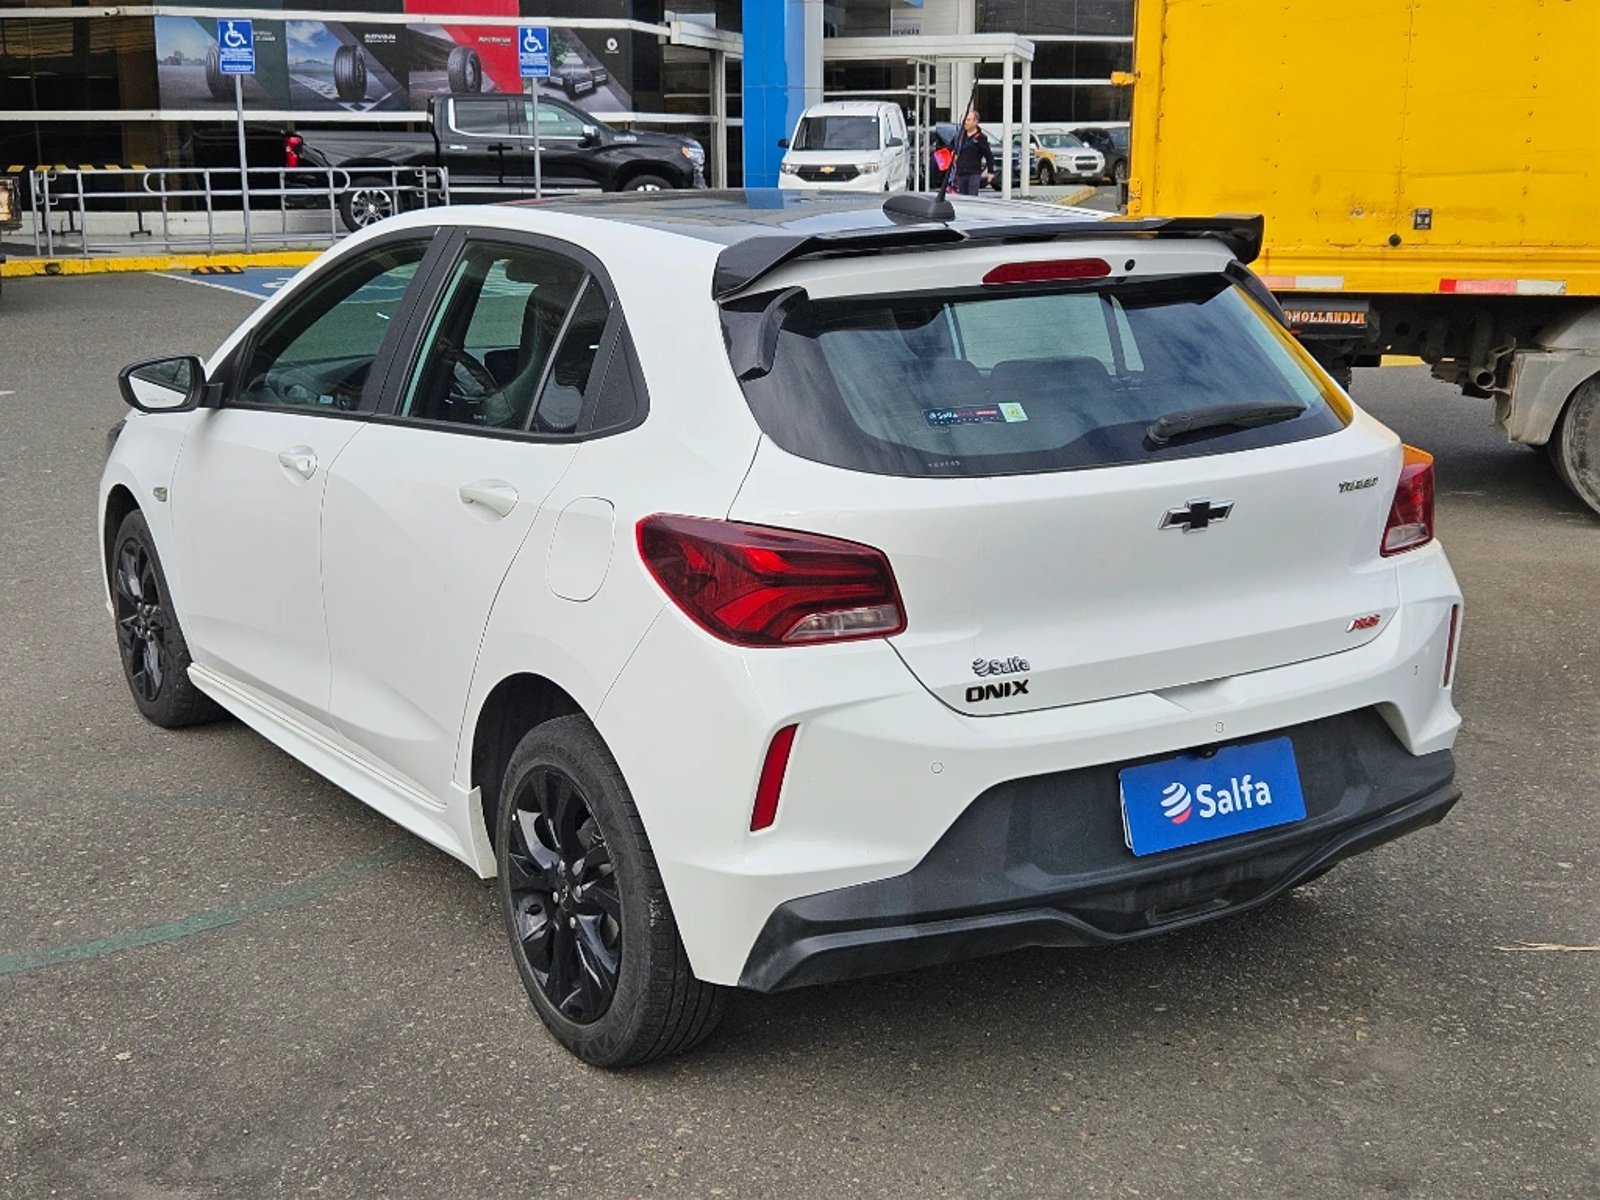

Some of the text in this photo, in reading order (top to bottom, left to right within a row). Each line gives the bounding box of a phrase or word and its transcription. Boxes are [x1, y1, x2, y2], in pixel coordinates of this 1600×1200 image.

[988, 655, 1031, 676] Salfa
[965, 679, 1029, 703] ONIX
[1196, 774, 1273, 818] Salfa
